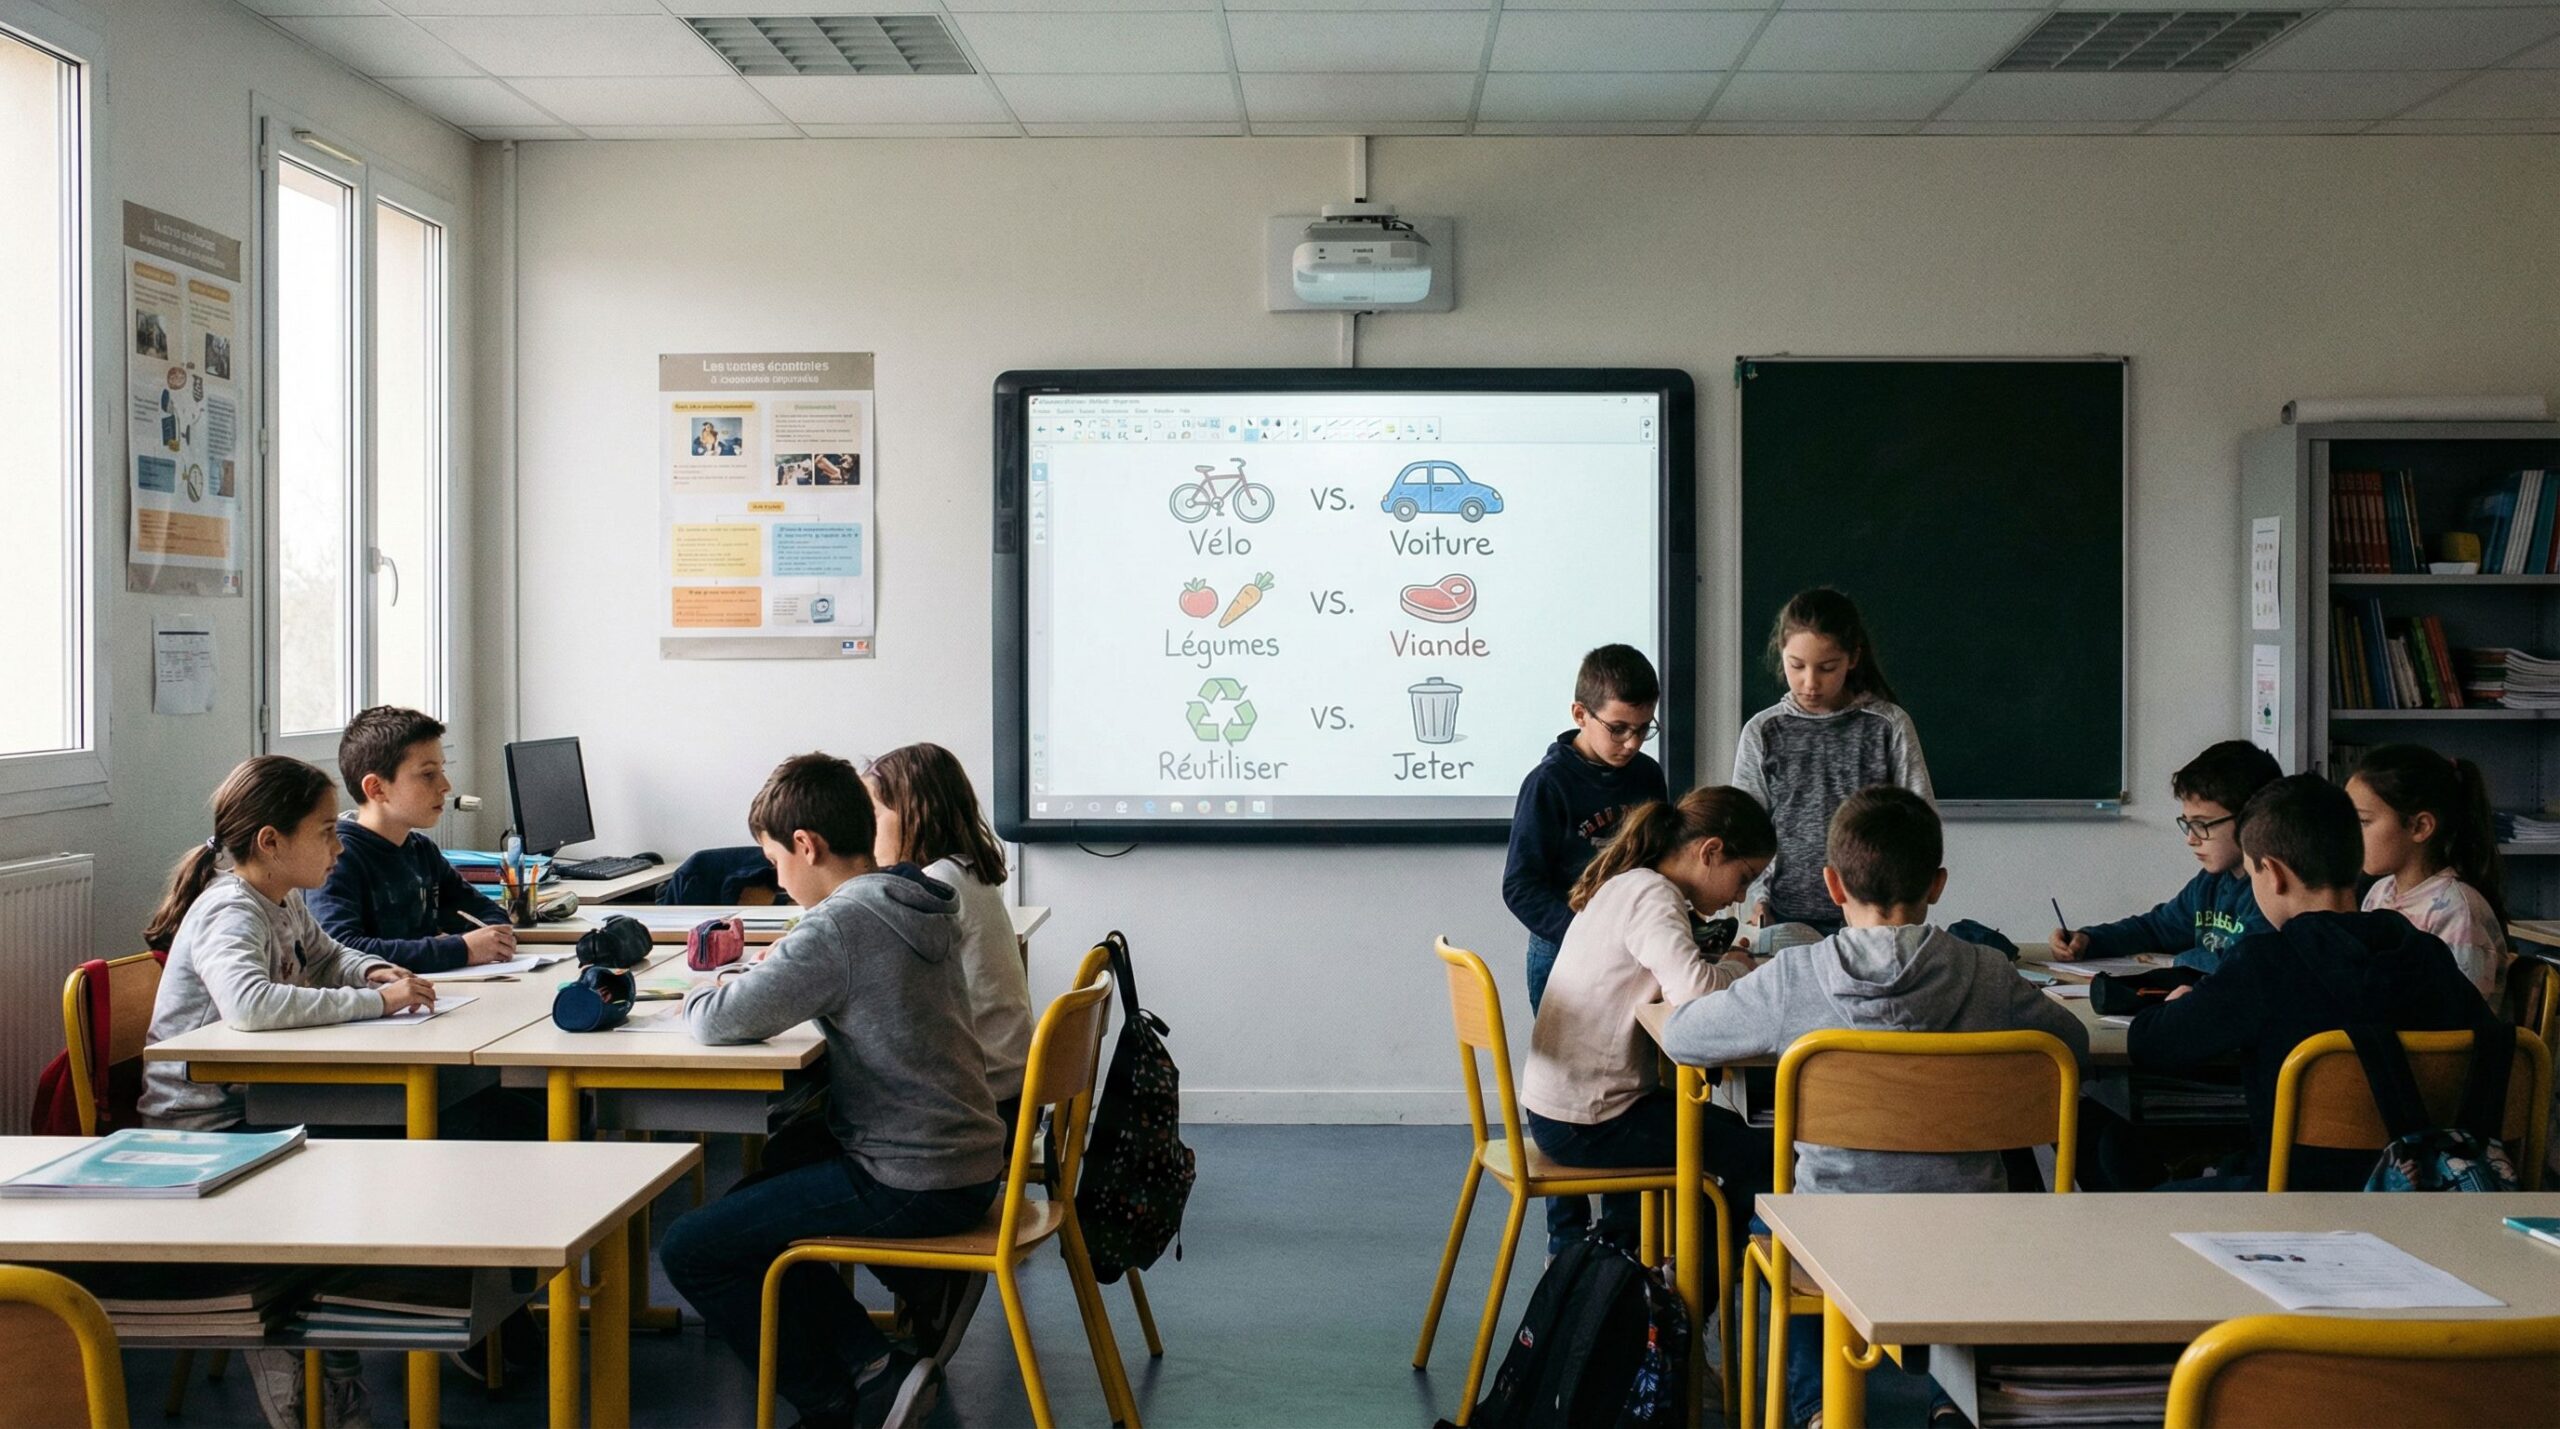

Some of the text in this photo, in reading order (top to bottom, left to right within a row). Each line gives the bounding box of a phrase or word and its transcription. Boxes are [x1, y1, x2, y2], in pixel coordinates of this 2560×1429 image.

[703, 360, 724, 372] Les
[1188, 527, 1252, 555] Vélo
[1390, 527, 1494, 555] Voiture
[1166, 629, 1279, 668] Légumes
[1390, 628, 1490, 657] Viande
[1160, 749, 1288, 780] Réutiliser
[1393, 751, 1474, 780] Jeter
